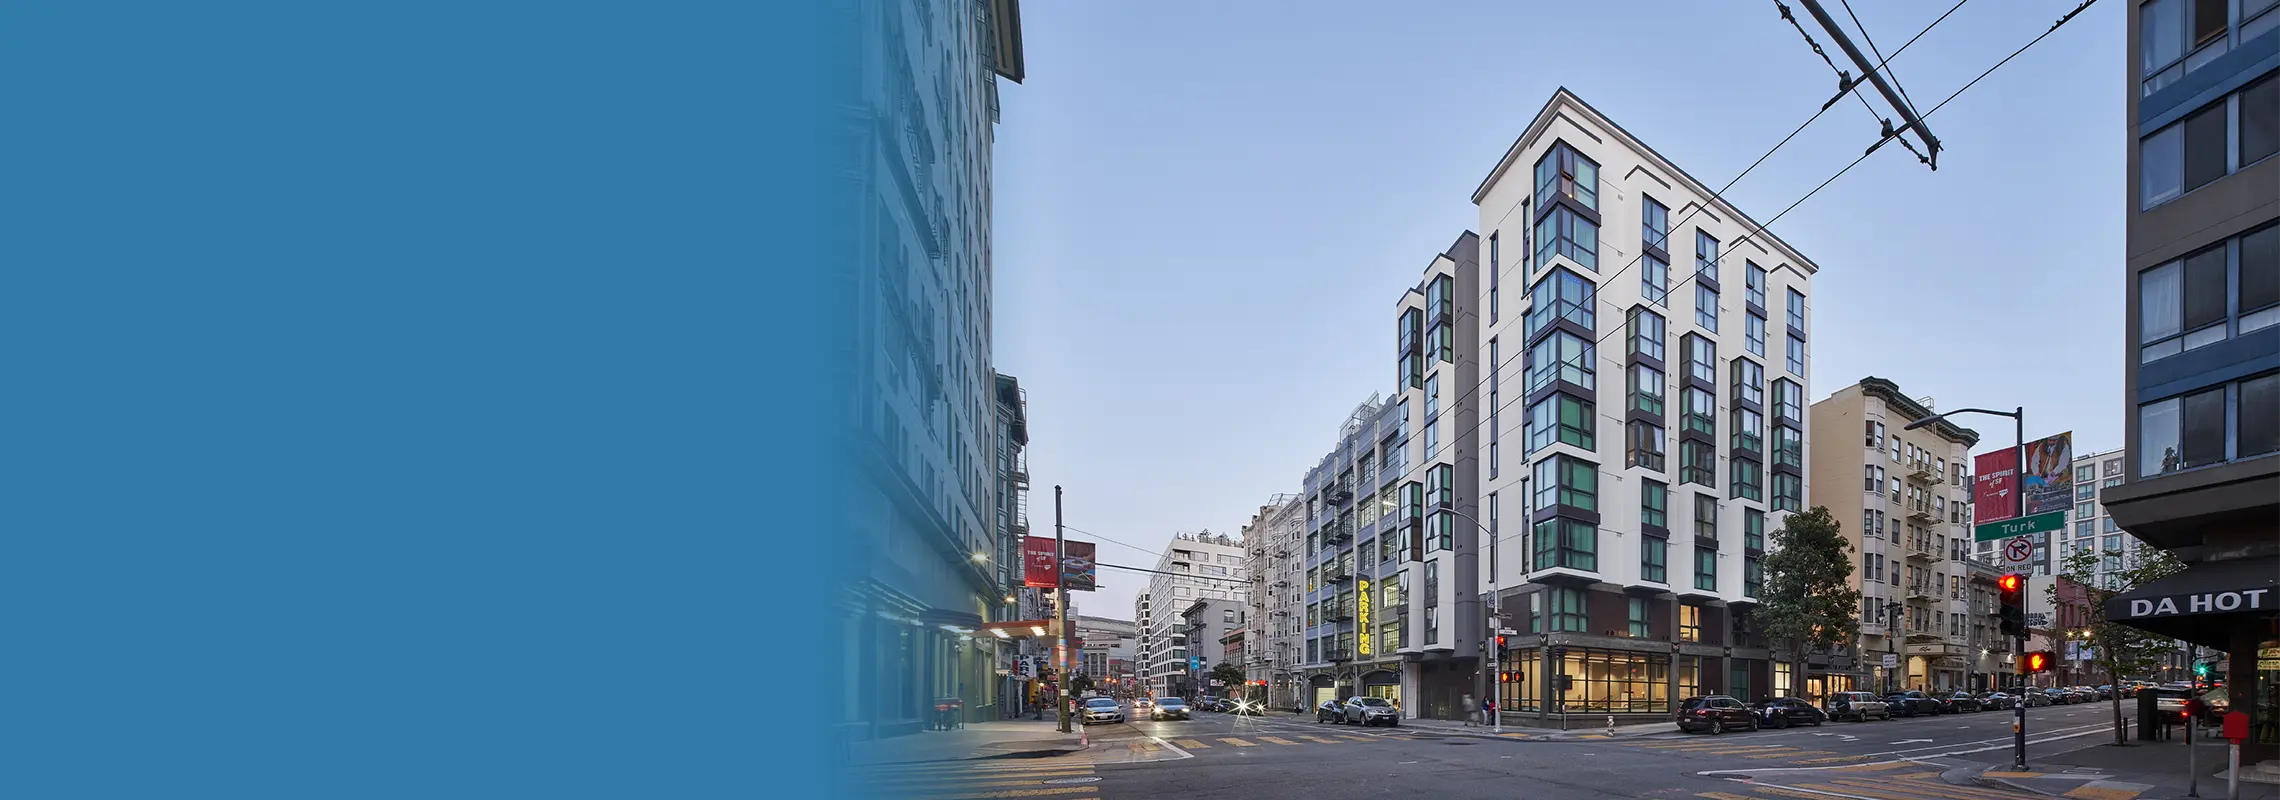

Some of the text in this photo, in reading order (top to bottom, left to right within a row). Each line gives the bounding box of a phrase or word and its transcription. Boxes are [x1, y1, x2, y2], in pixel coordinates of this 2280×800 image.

[1980, 469, 2014, 482] THE SPIRIT
[1990, 480, 1995, 488] of
[2002, 520, 2035, 534] Turk
[2130, 588, 2268, 616] DA HOT
[1359, 581, 1369, 654] PARKING
